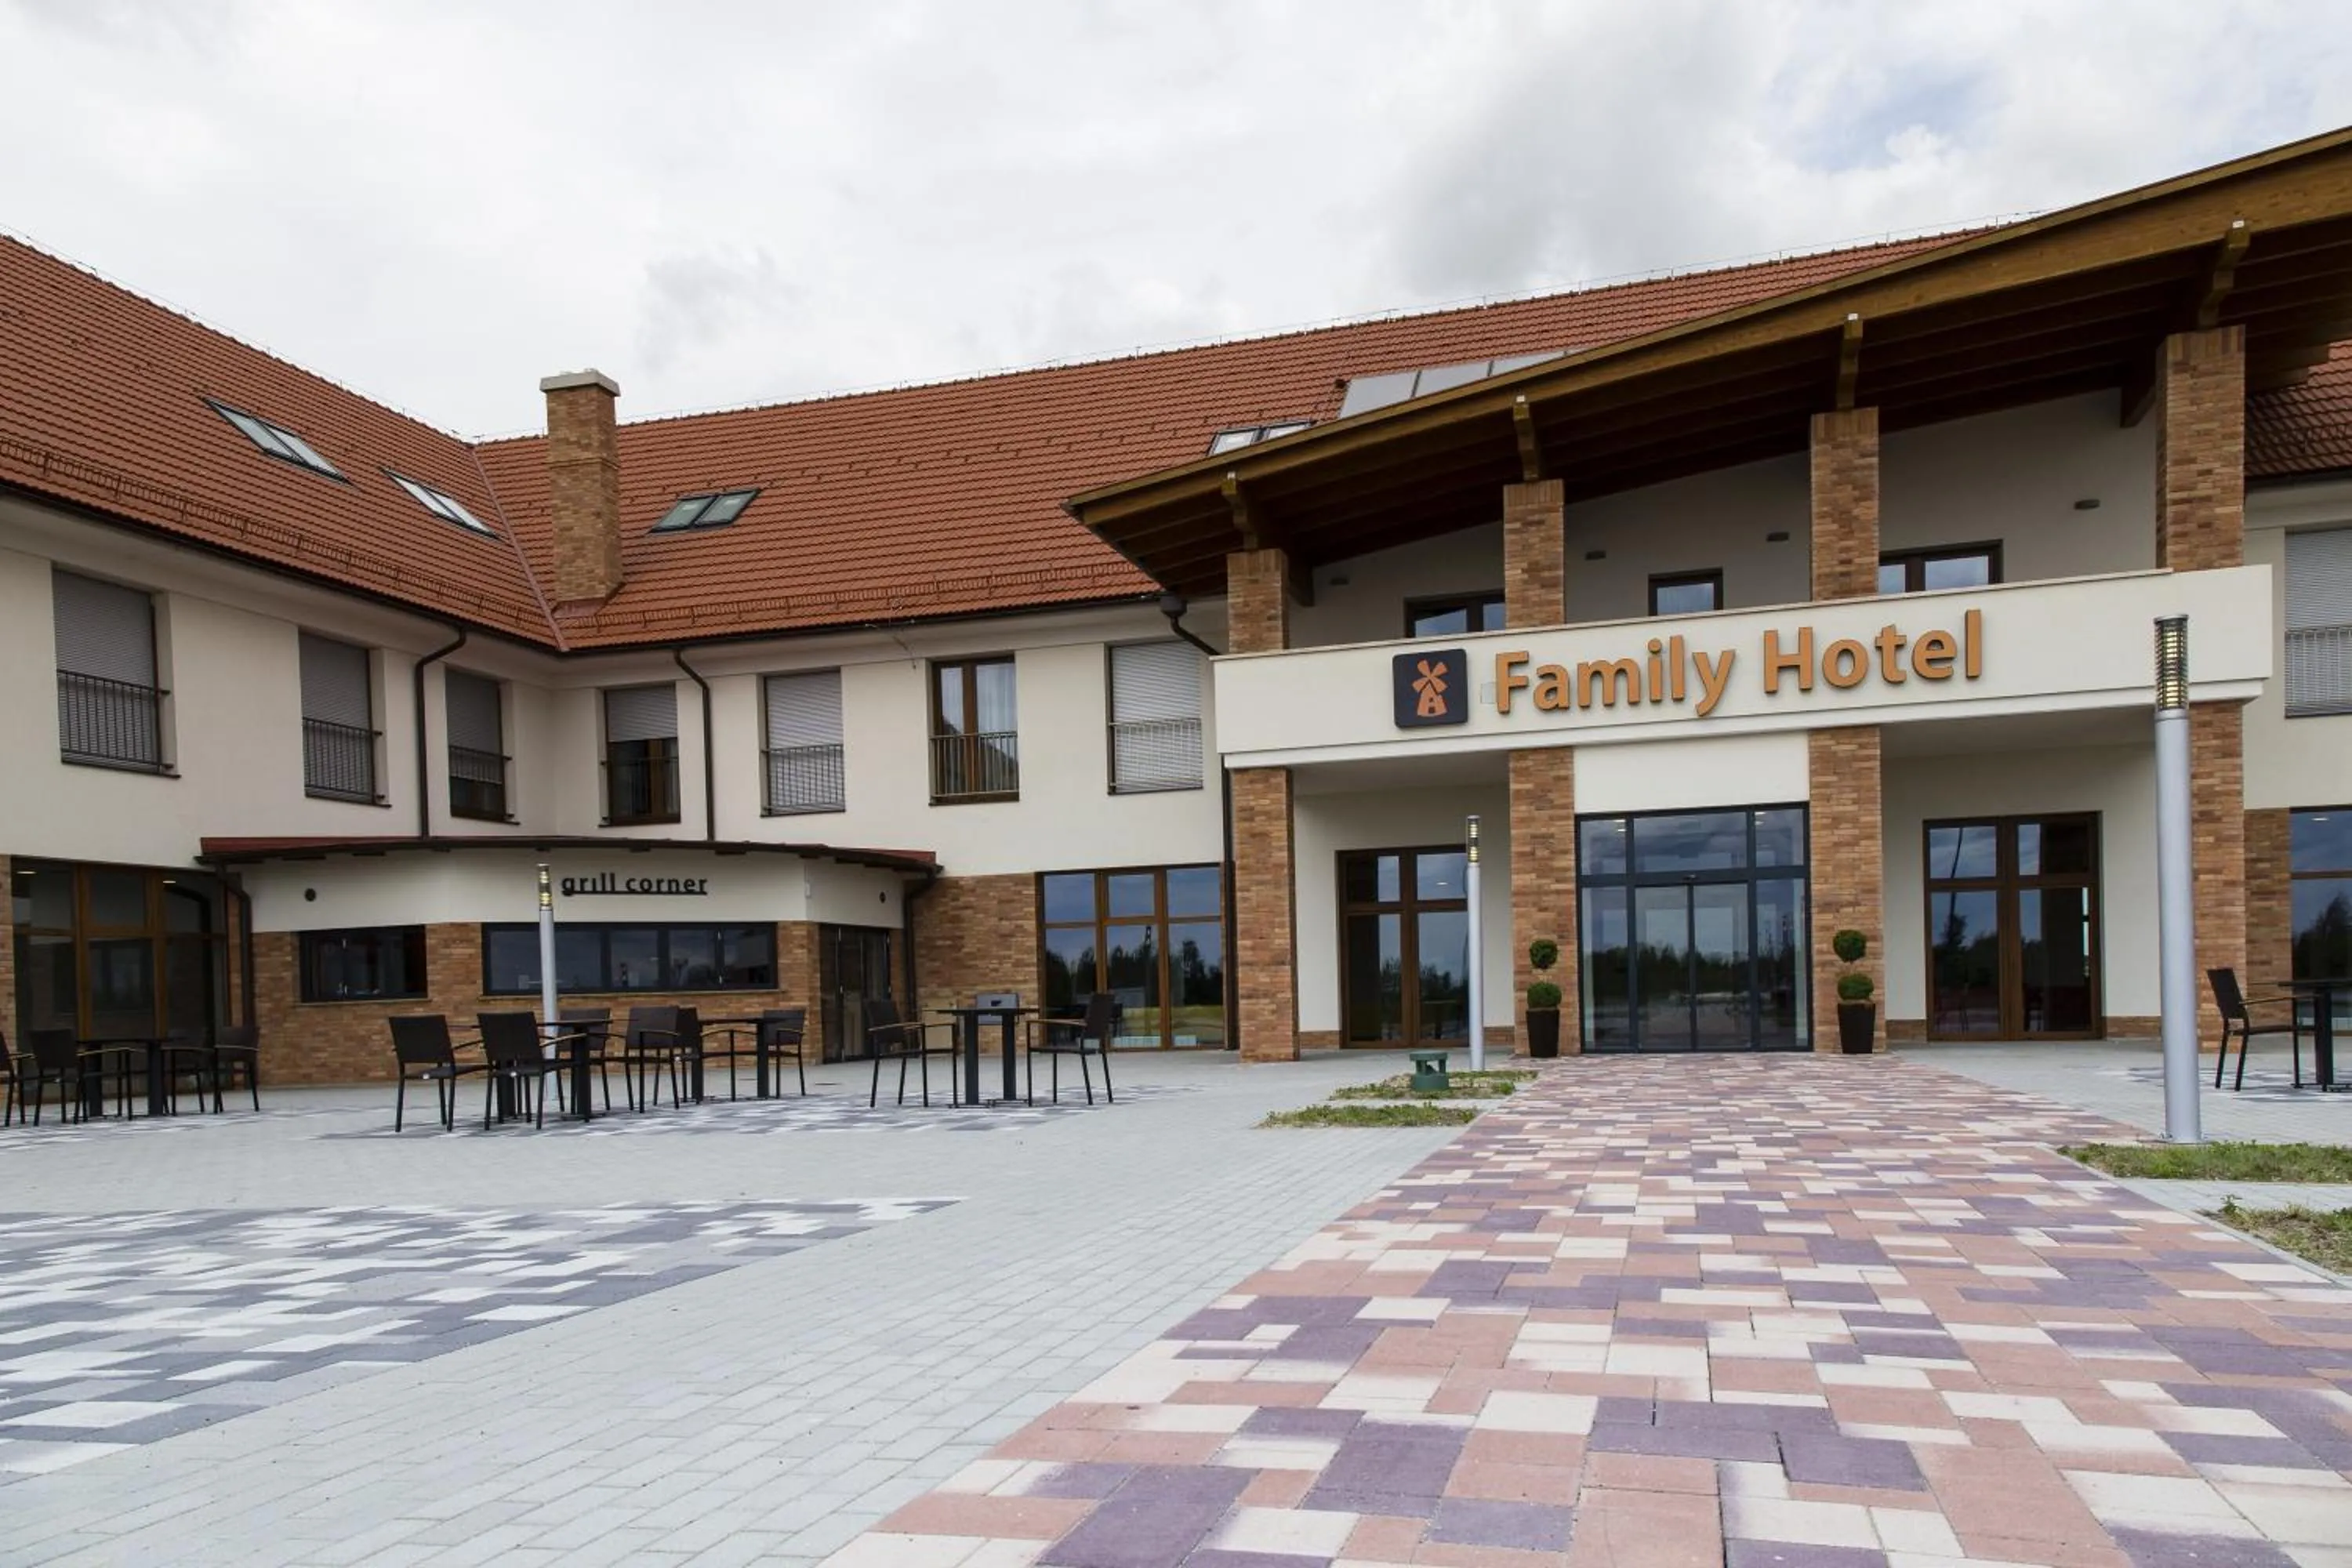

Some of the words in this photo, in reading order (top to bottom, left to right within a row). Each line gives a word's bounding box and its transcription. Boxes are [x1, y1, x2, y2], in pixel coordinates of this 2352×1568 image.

[1494, 634, 1736, 717] Family
[1762, 608, 1982, 695] Hotel
[561, 872, 615, 896] grill
[625, 877, 708, 895] corner
